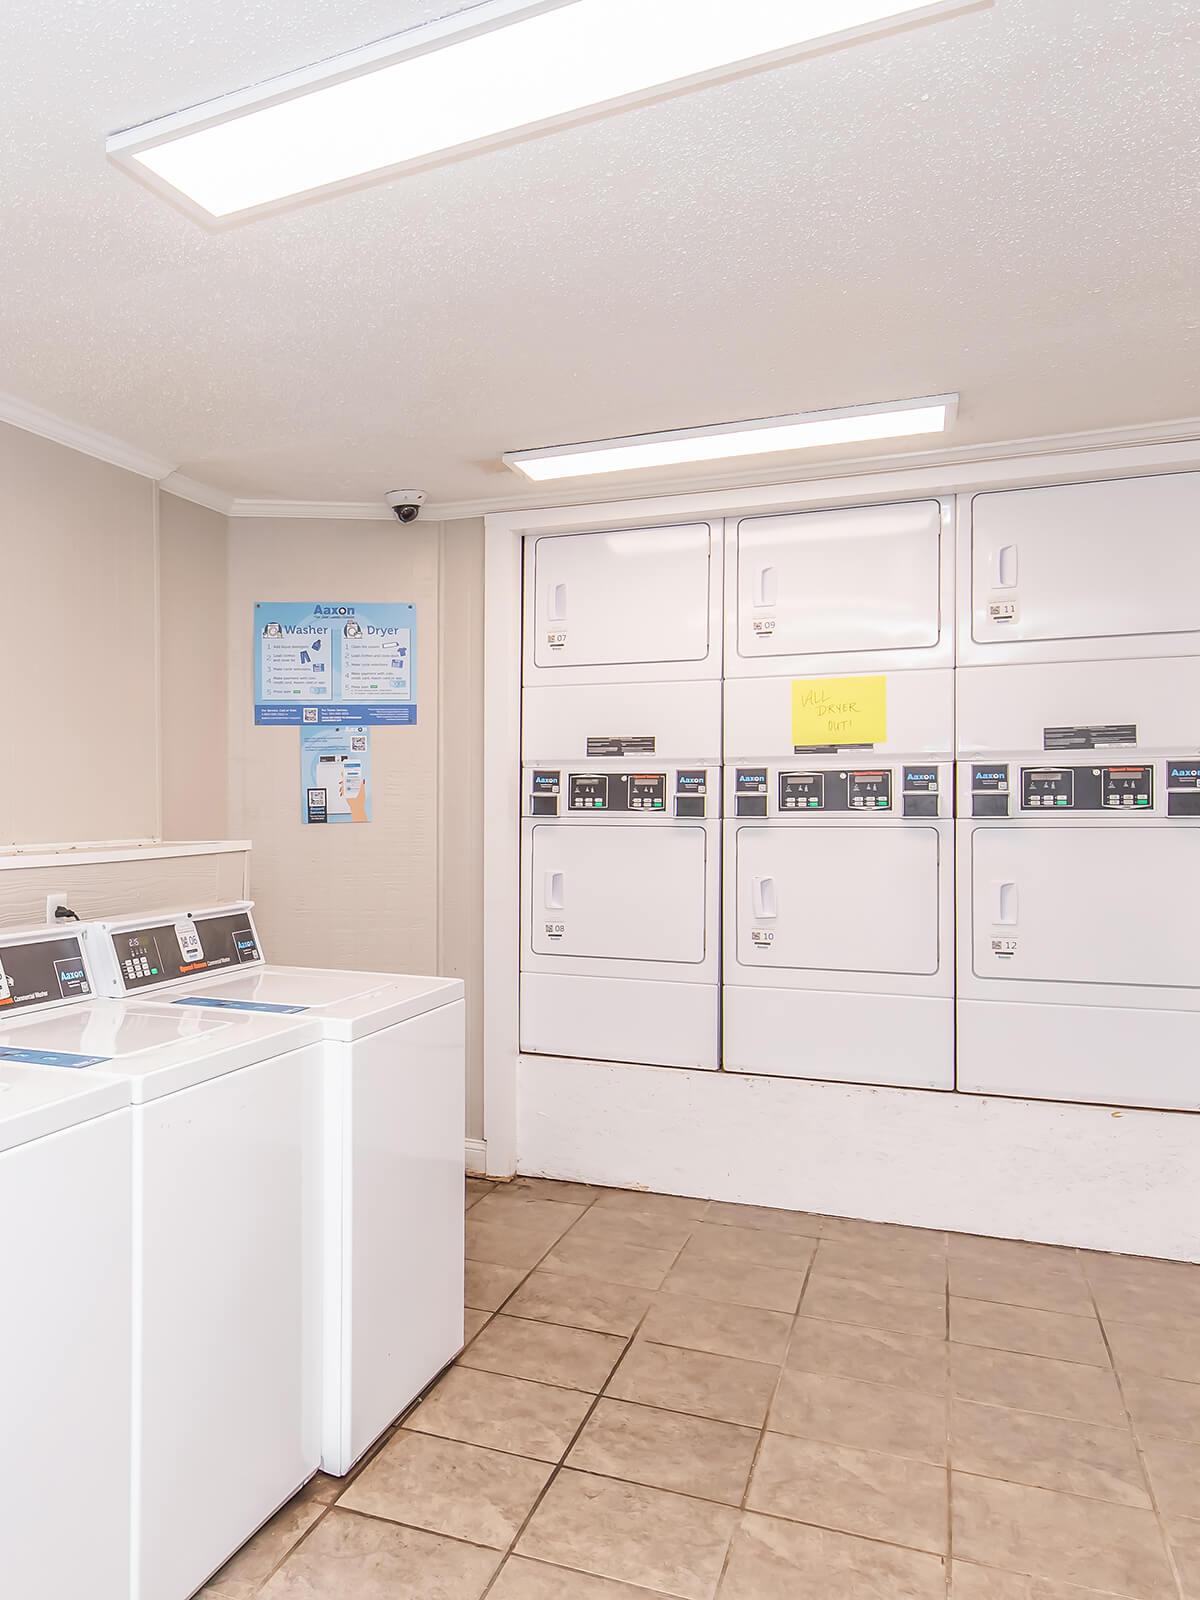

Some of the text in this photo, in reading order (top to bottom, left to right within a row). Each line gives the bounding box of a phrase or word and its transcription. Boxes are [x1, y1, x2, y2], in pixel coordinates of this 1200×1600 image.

[313, 604, 356, 615] Aaxon
[1004, 604, 1015, 613] 11
[284, 625, 328, 635] Washer
[367, 625, 398, 637] Dryer
[557, 634, 567, 642] 07
[817, 702, 861, 717] DRYER
[739, 775, 765, 783] Aaxon
[975, 771, 1005, 779] Aaxon
[535, 776, 558, 784] Aaxon
[679, 776, 704, 784] Aaxon
[764, 932, 774, 941] 10
[1005, 941, 1017, 950] 12
[61, 970, 84, 981] Aaxon
